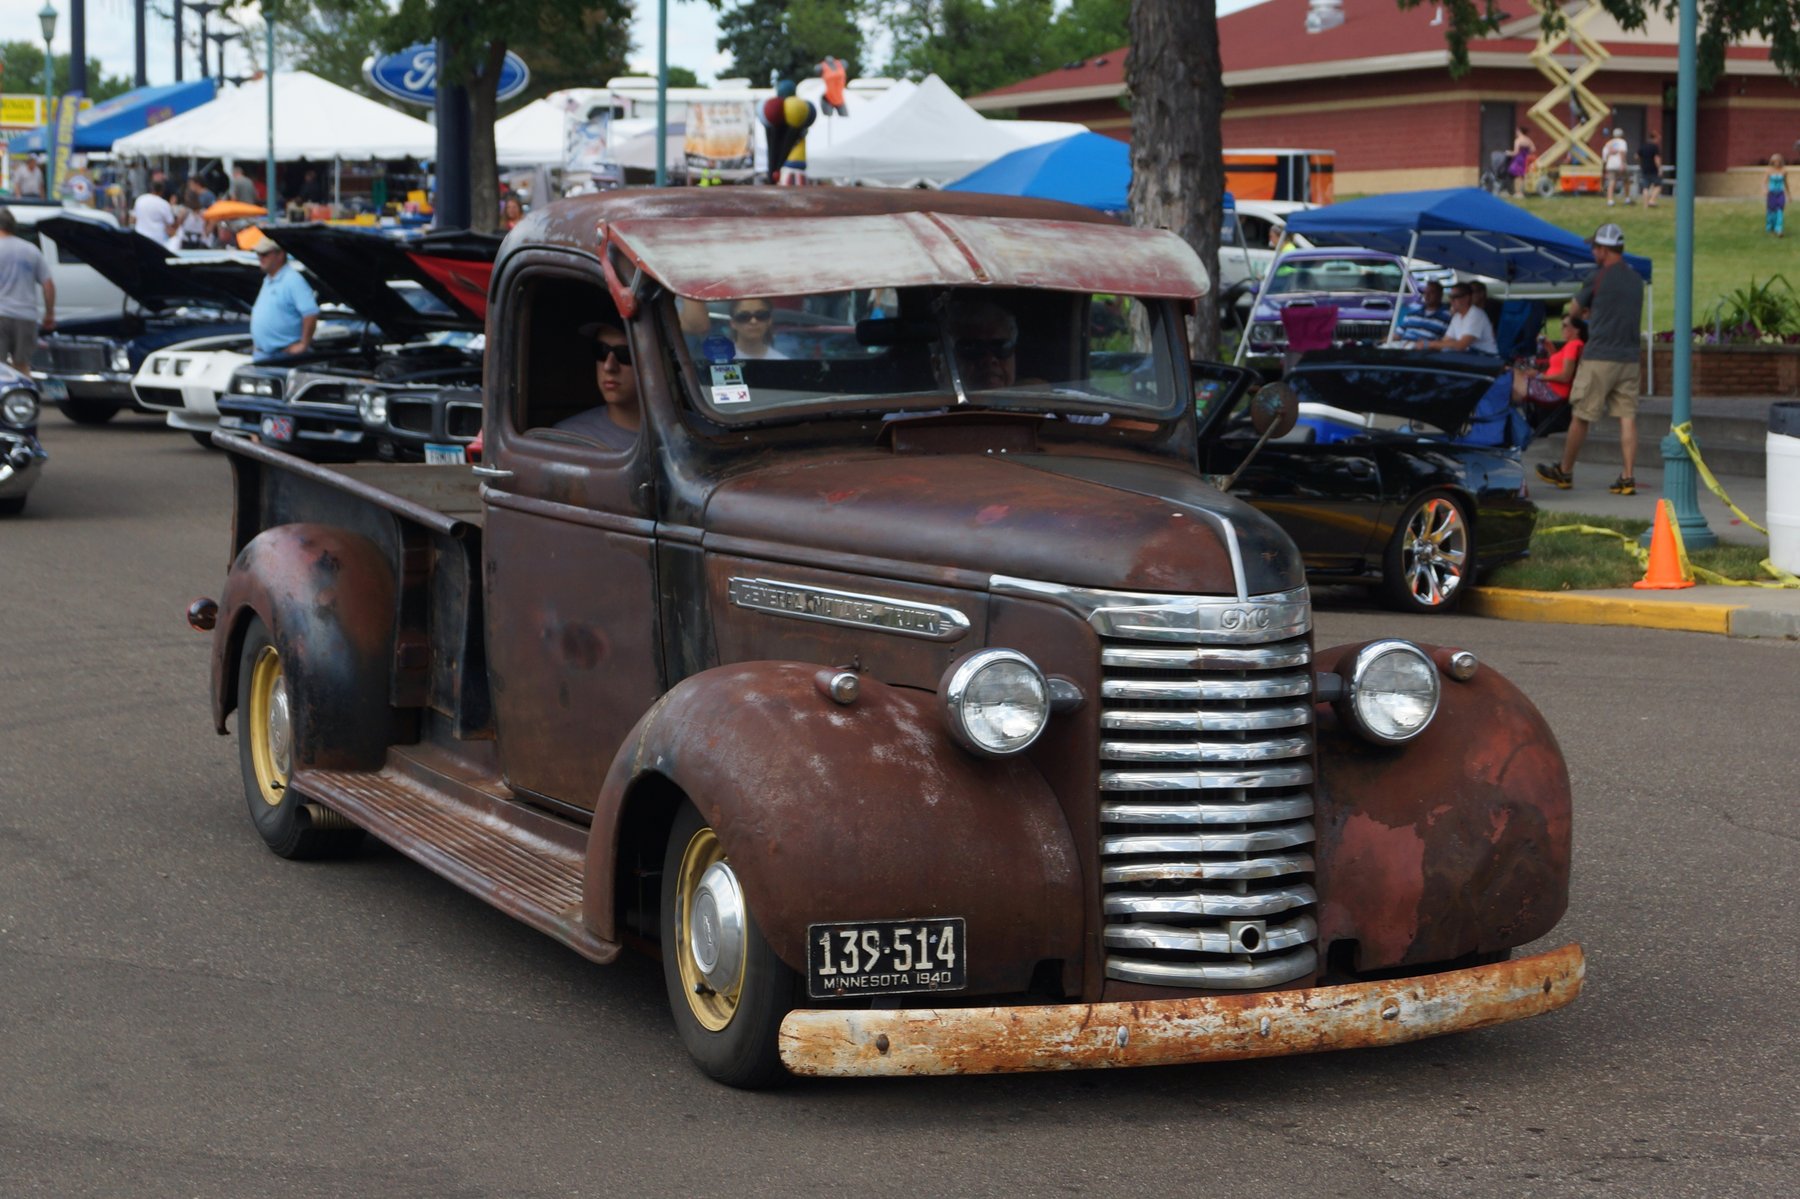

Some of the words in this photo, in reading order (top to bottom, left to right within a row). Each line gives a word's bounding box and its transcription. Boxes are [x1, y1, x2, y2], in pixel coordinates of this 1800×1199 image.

[741, 584, 804, 609] GENERAL
[812, 595, 874, 620] MOTORS
[884, 606, 937, 632] TRUCK
[1221, 608, 1270, 631] GMC
[824, 974, 910, 990] MINNESOTA
[916, 972, 952, 985] 1940
